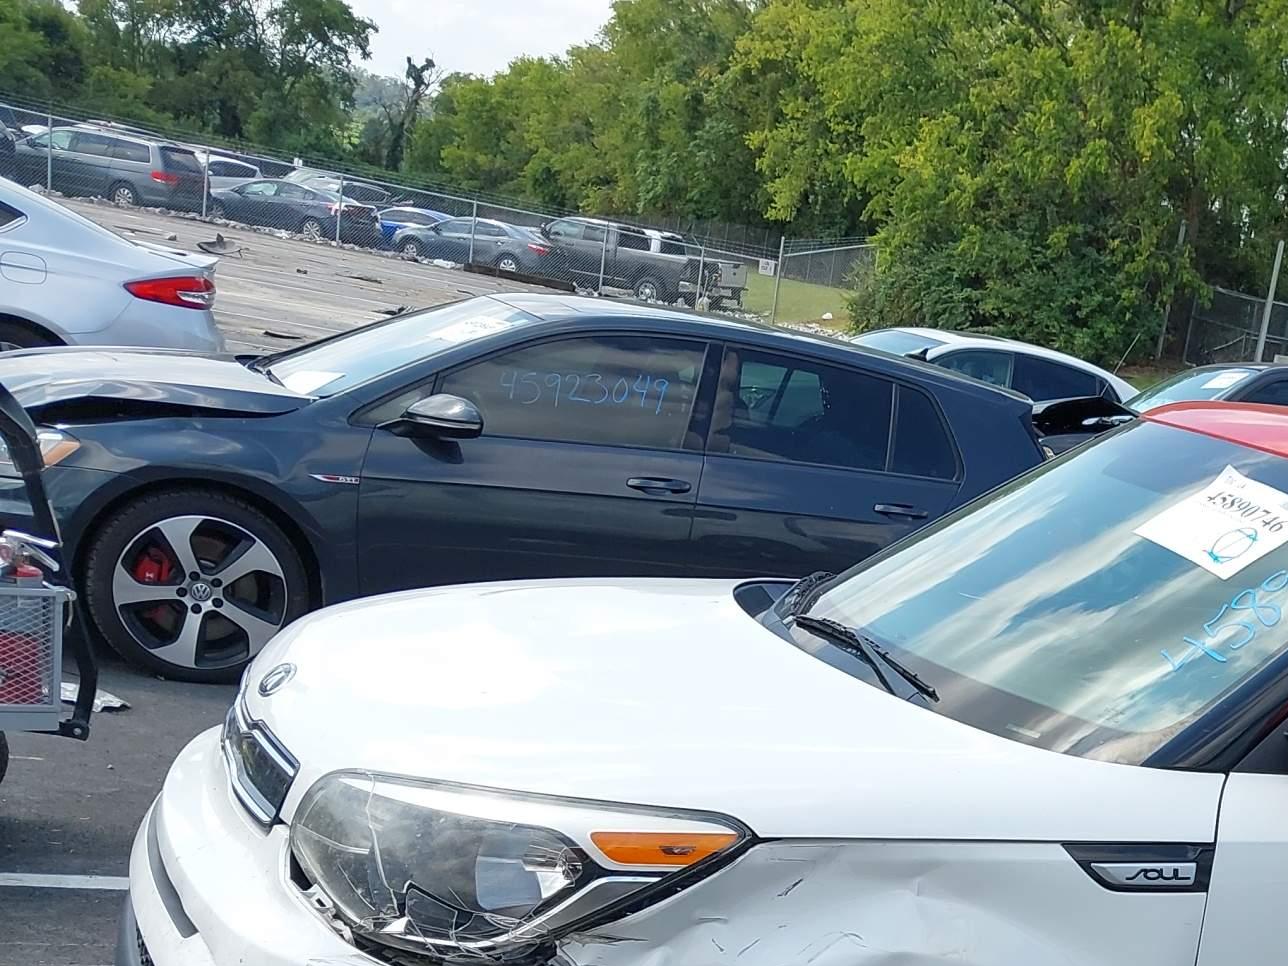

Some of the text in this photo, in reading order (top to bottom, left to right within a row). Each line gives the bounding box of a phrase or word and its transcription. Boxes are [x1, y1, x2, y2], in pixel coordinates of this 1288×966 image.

[501, 371, 669, 415] 45923049
[1207, 491, 1288, 533] 45890746
[1125, 868, 1191, 880] SOUL
